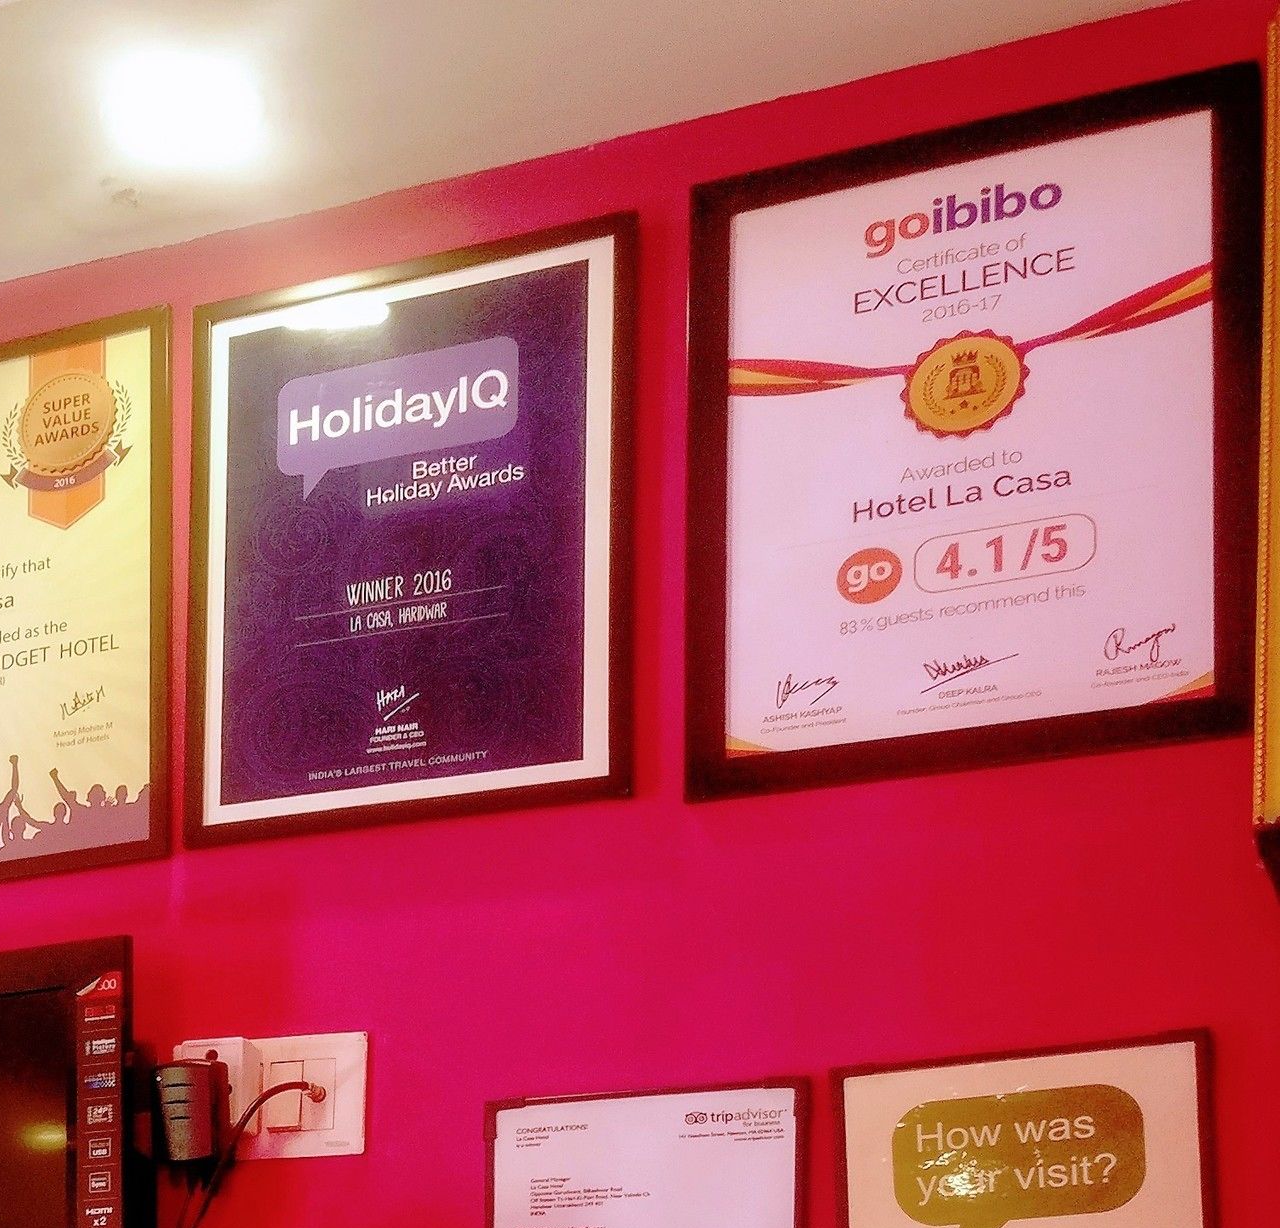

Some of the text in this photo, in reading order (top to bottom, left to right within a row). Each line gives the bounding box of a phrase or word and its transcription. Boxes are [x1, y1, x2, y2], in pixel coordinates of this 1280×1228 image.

[864, 180, 1063, 258] goibibo
[896, 233, 1027, 275] Certificate of
[853, 246, 1076, 314] EXCELLENCE
[922, 294, 1001, 324] 2016-17
[41, 406, 90, 429] VALUE
[42, 392, 90, 414] SUPER
[289, 369, 509, 445] HolidayIQ
[33, 421, 100, 448] AWARDS
[53, 475, 75, 488] 2016
[412, 453, 478, 481] Better
[900, 448, 1023, 484] Awarded to
[366, 462, 524, 508] Holiday Awards
[852, 468, 1072, 523] Hotel La Casa
[347, 570, 452, 606] WINNER 2016
[846, 557, 894, 593] go
[349, 616, 361, 633] LA
[398, 602, 447, 625] HARIDWAR
[59, 633, 119, 660] HOTEL
[916, 1115, 1096, 1153] How was
[1014, 1153, 1117, 1191] visit?
